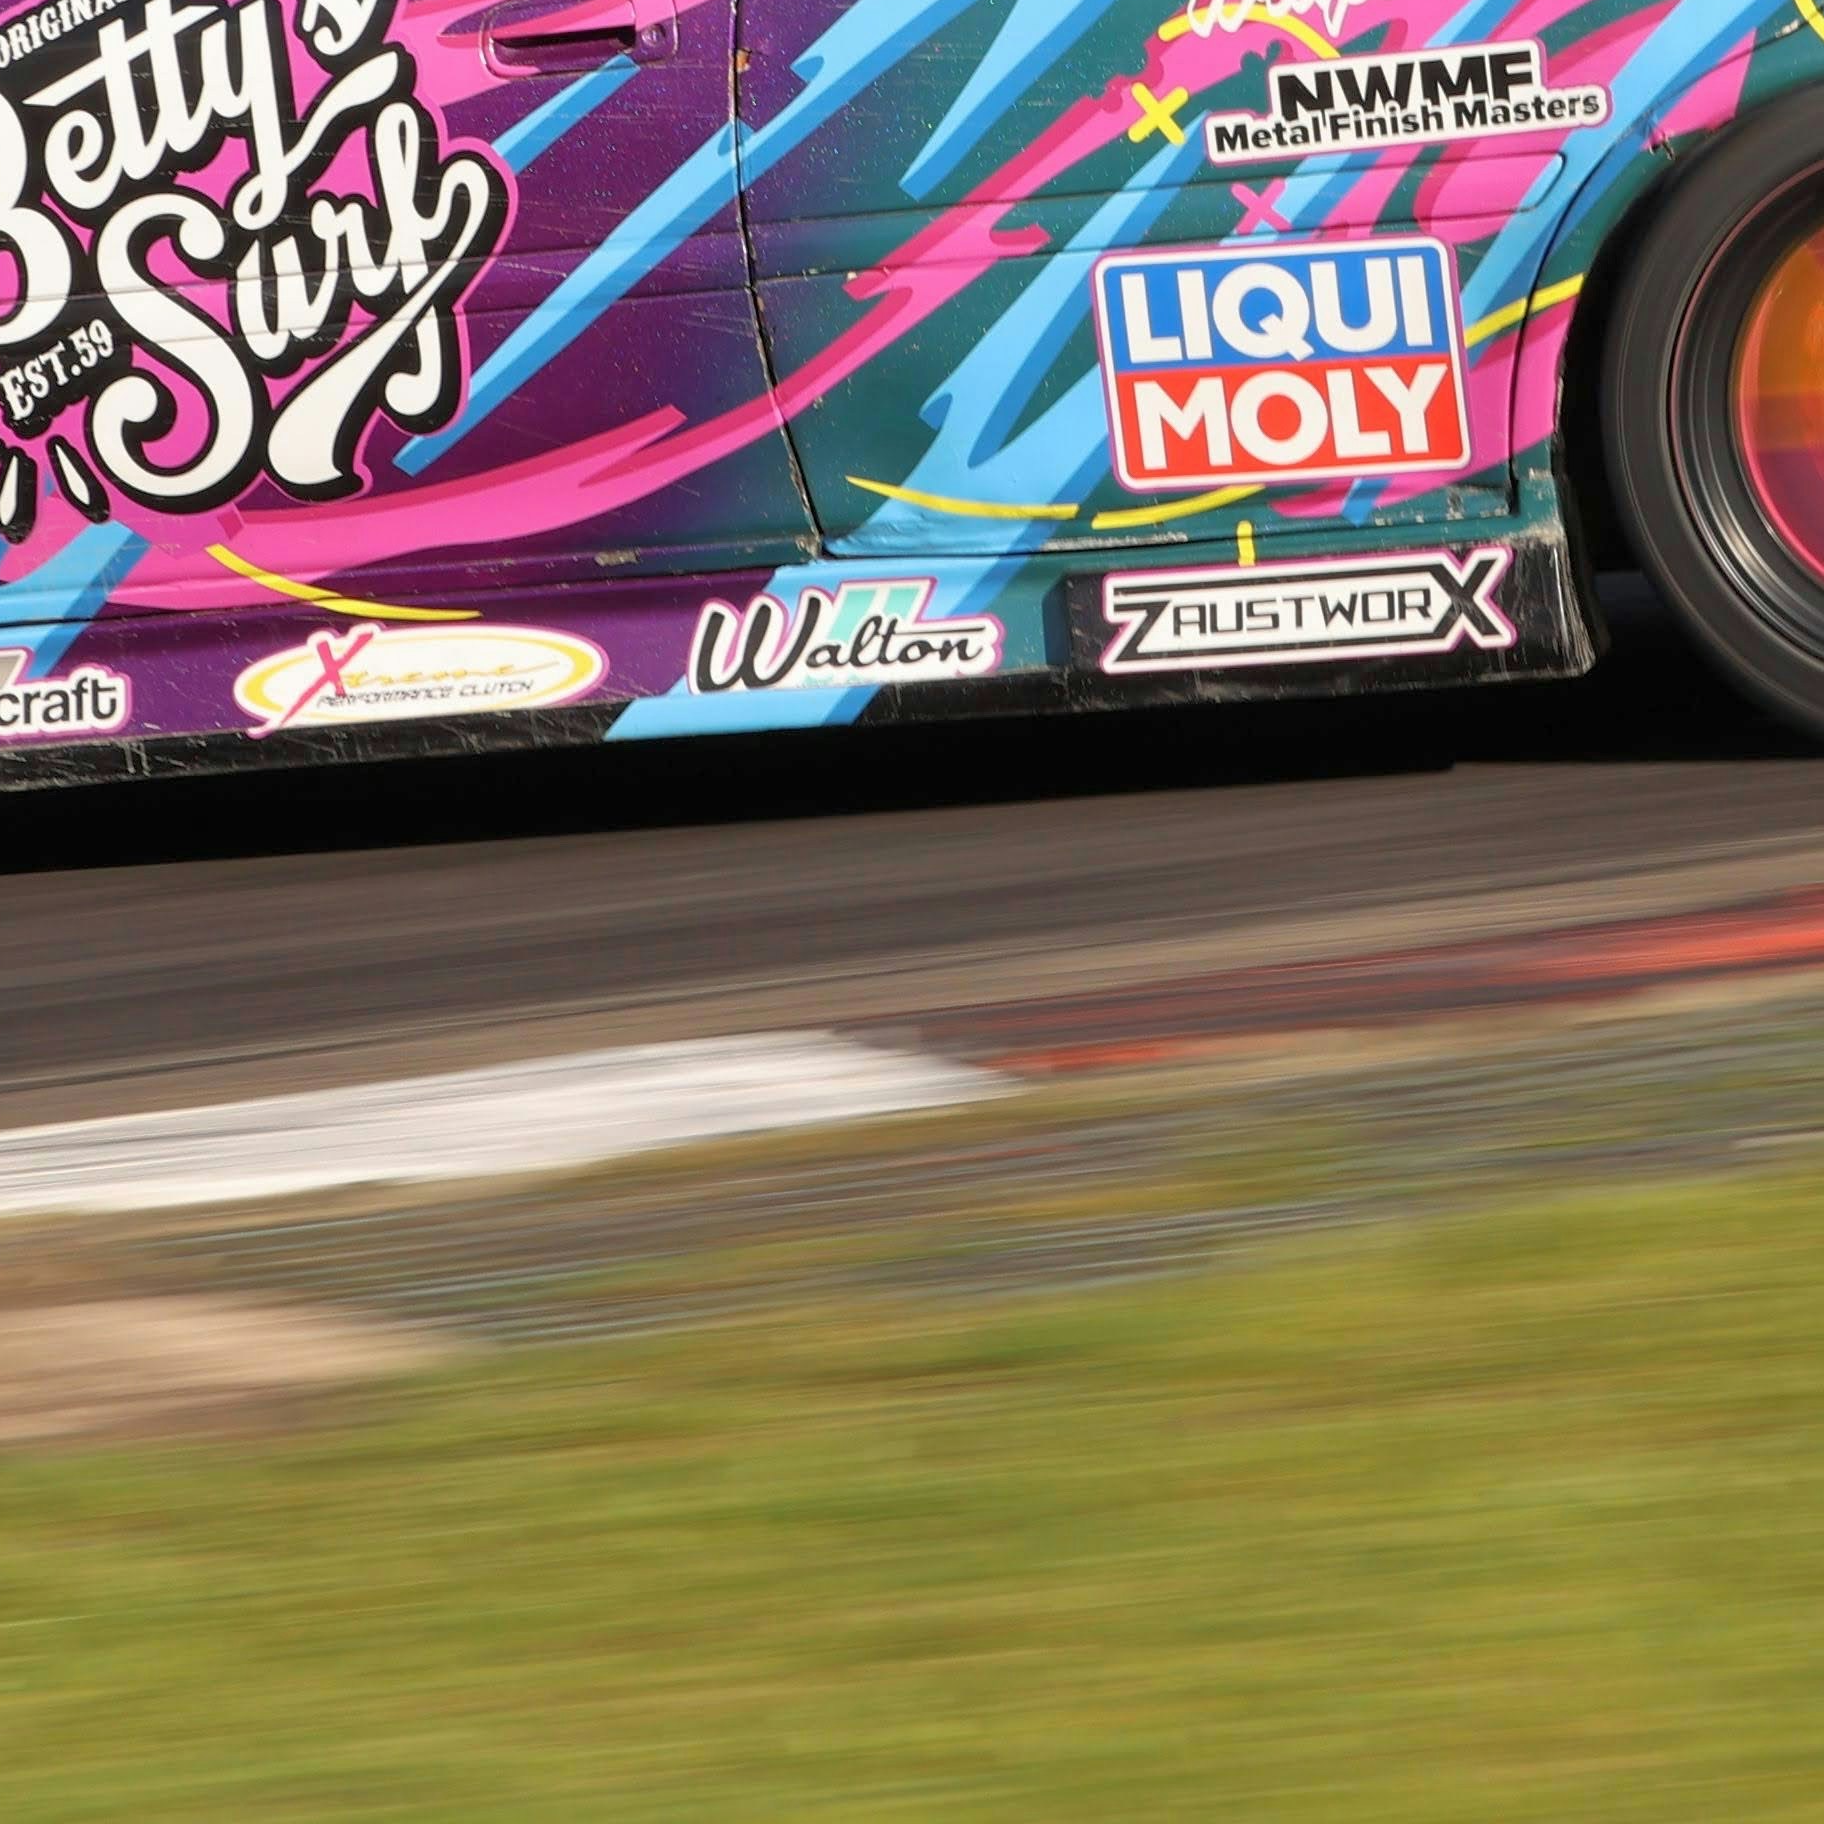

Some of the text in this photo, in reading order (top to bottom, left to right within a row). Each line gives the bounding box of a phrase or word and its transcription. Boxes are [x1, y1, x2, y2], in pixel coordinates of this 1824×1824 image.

[1214, 90, 1600, 154] Metal Finish Masters
[1276, 52, 1534, 124] NWMF
[92, 102, 491, 497] Surf
[1119, 255, 1435, 364] LIQUI
[1132, 363, 1449, 471] MOLY
[459, 678, 534, 701] CLUTCH
[697, 596, 986, 694] Walton
